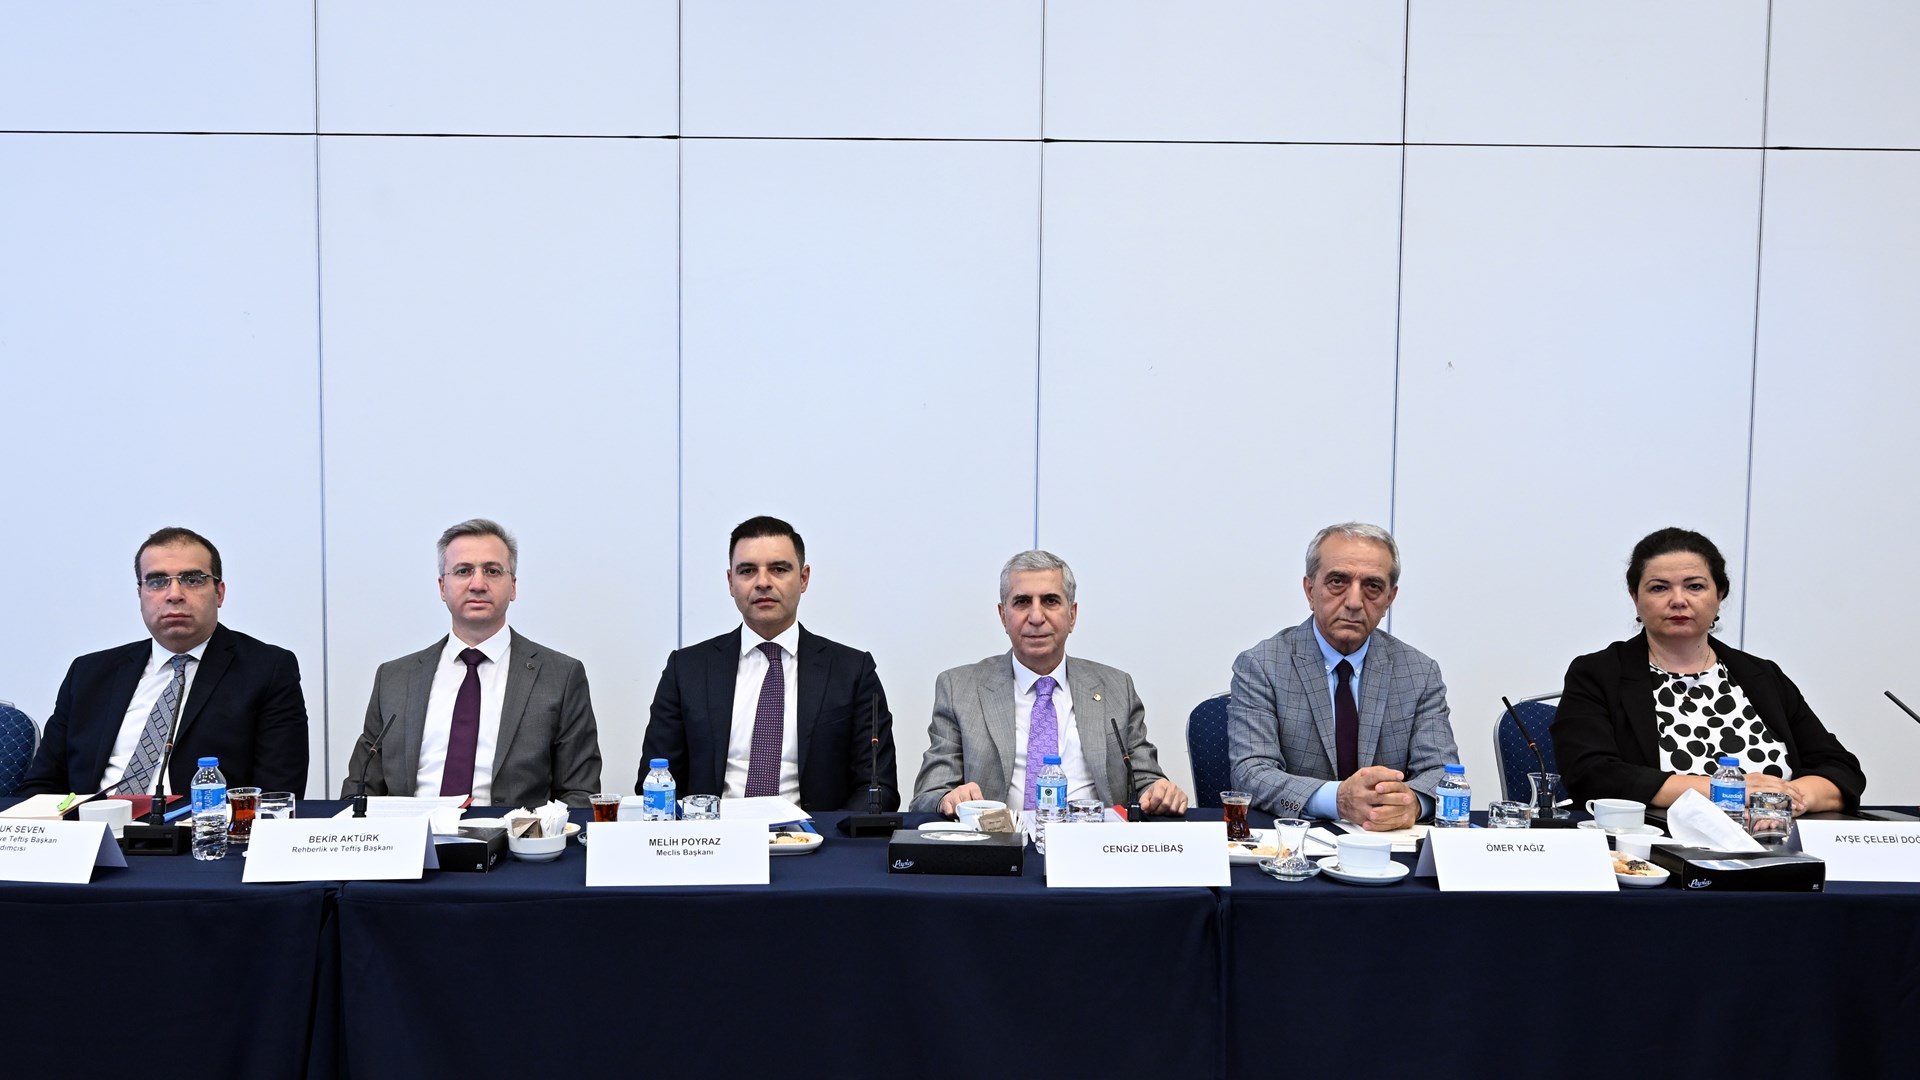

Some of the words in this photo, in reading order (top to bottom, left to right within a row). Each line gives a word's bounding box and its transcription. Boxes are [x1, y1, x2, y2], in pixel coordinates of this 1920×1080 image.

[14, 825, 46, 834] SEVEN
[9, 835, 29, 844] Teftiş
[30, 836, 58, 844] Başkan
[308, 833, 338, 844] BEKİR
[339, 833, 380, 843] AKTÜRK
[648, 836, 679, 847] MELİH
[681, 837, 721, 846] POYRAZ
[1835, 834, 1861, 845] AYŞE
[1863, 834, 1899, 845] ÇELEBİ
[291, 845, 328, 853] Rehberlik
[341, 845, 362, 853] Teftiş
[363, 844, 394, 853] Başkanı
[1102, 843, 1140, 854] CENGİZ
[1141, 842, 1184, 854] DELİBAŞ
[1486, 842, 1515, 852] ÖMER
[1516, 843, 1546, 852] YAĞIZ
[656, 849, 681, 857] Meclis
[682, 848, 714, 857] Başkanı
